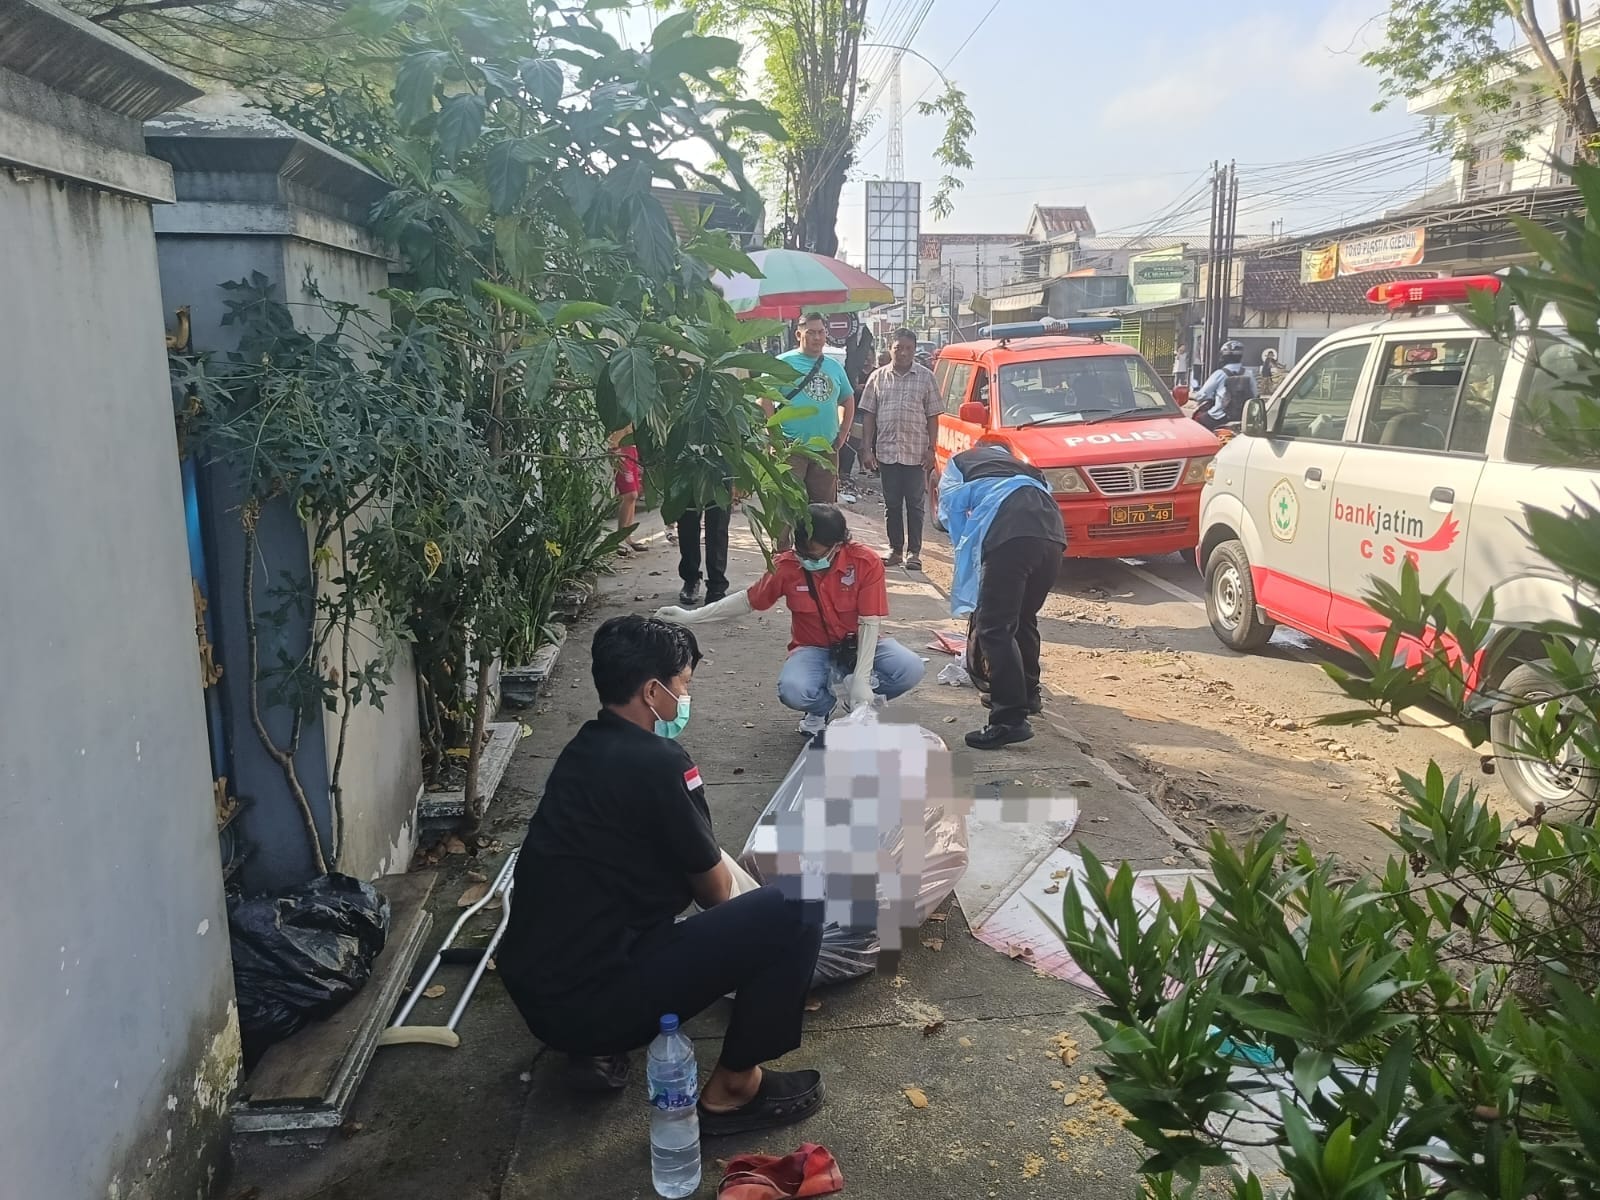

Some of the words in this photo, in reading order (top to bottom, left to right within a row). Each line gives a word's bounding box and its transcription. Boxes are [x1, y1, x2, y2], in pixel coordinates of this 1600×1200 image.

[1064, 430, 1177, 447] POLISI
[1131, 511, 1145, 523] 70
[1334, 497, 1424, 538] bankjatim
